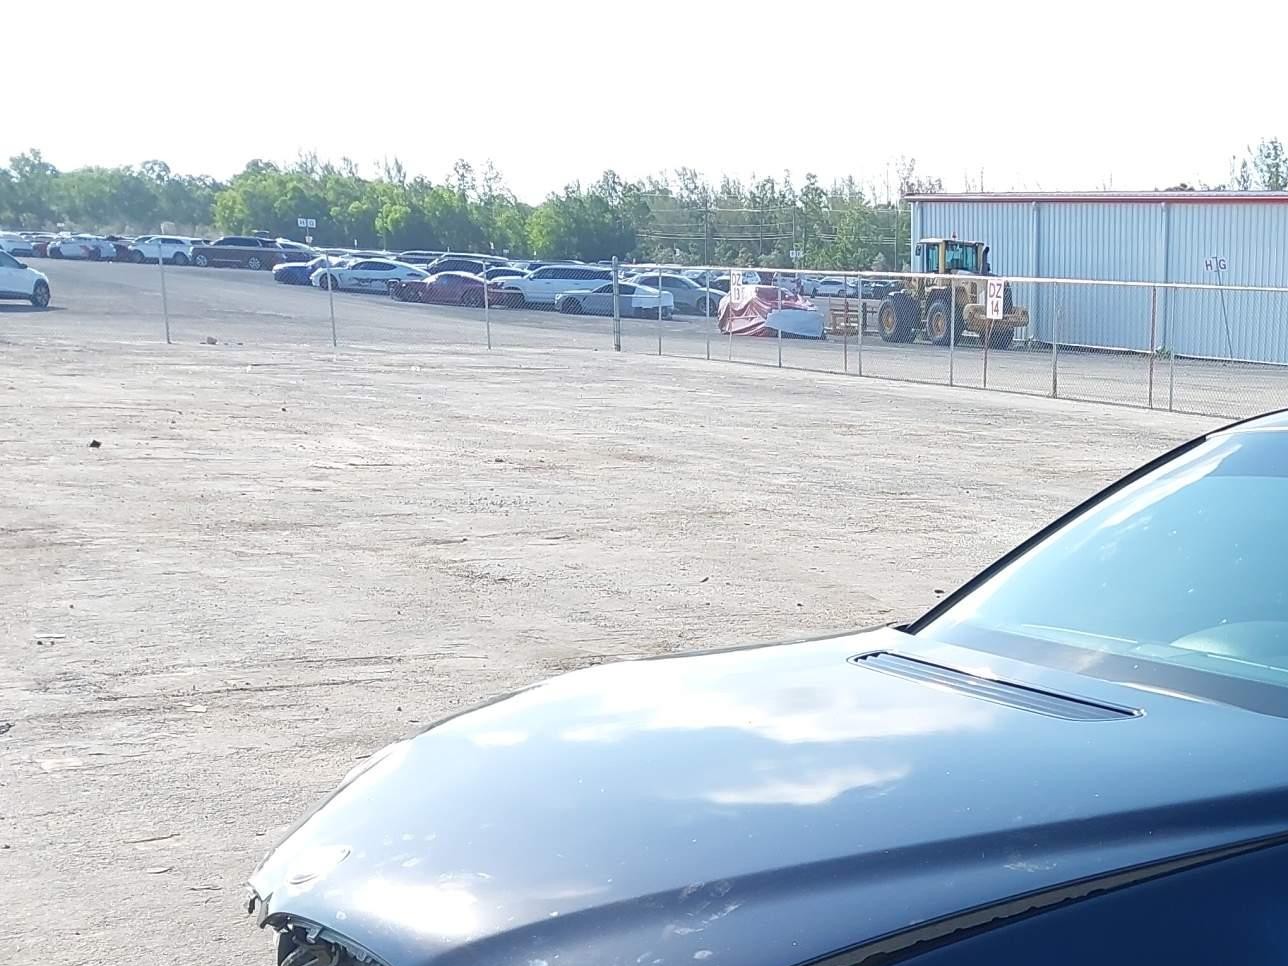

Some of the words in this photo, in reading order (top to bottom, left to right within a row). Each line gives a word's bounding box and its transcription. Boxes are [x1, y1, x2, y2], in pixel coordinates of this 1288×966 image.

[1205, 259, 1213, 271] H
[1218, 258, 1227, 270] G
[731, 272, 741, 286] DZ
[989, 282, 1002, 298] DZ
[991, 300, 999, 316] 14
